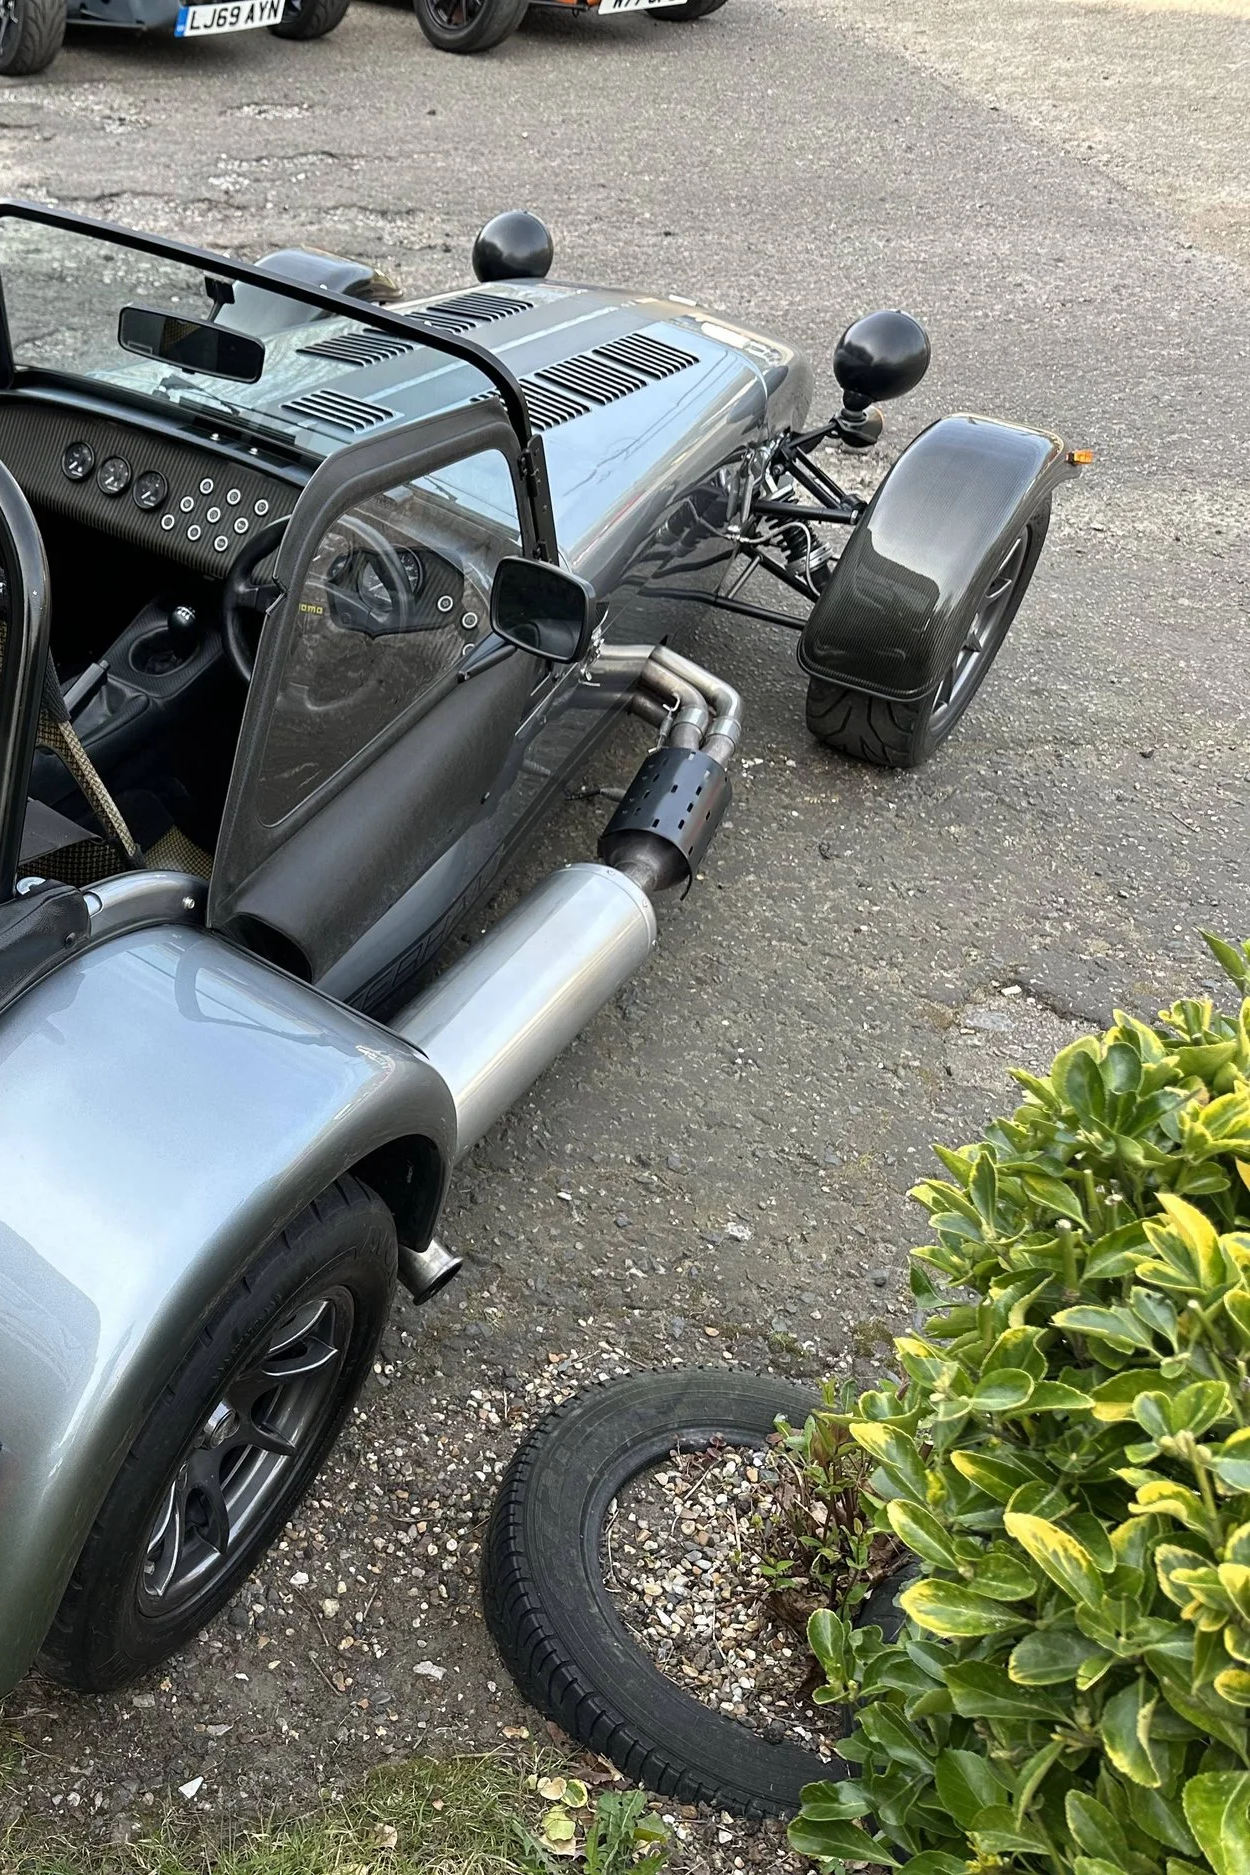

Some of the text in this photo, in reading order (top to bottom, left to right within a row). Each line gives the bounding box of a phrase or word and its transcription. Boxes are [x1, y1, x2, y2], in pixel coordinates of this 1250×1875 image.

[190, 0, 280, 30] LJ69 AYN
[299, 603, 323, 615] omo
